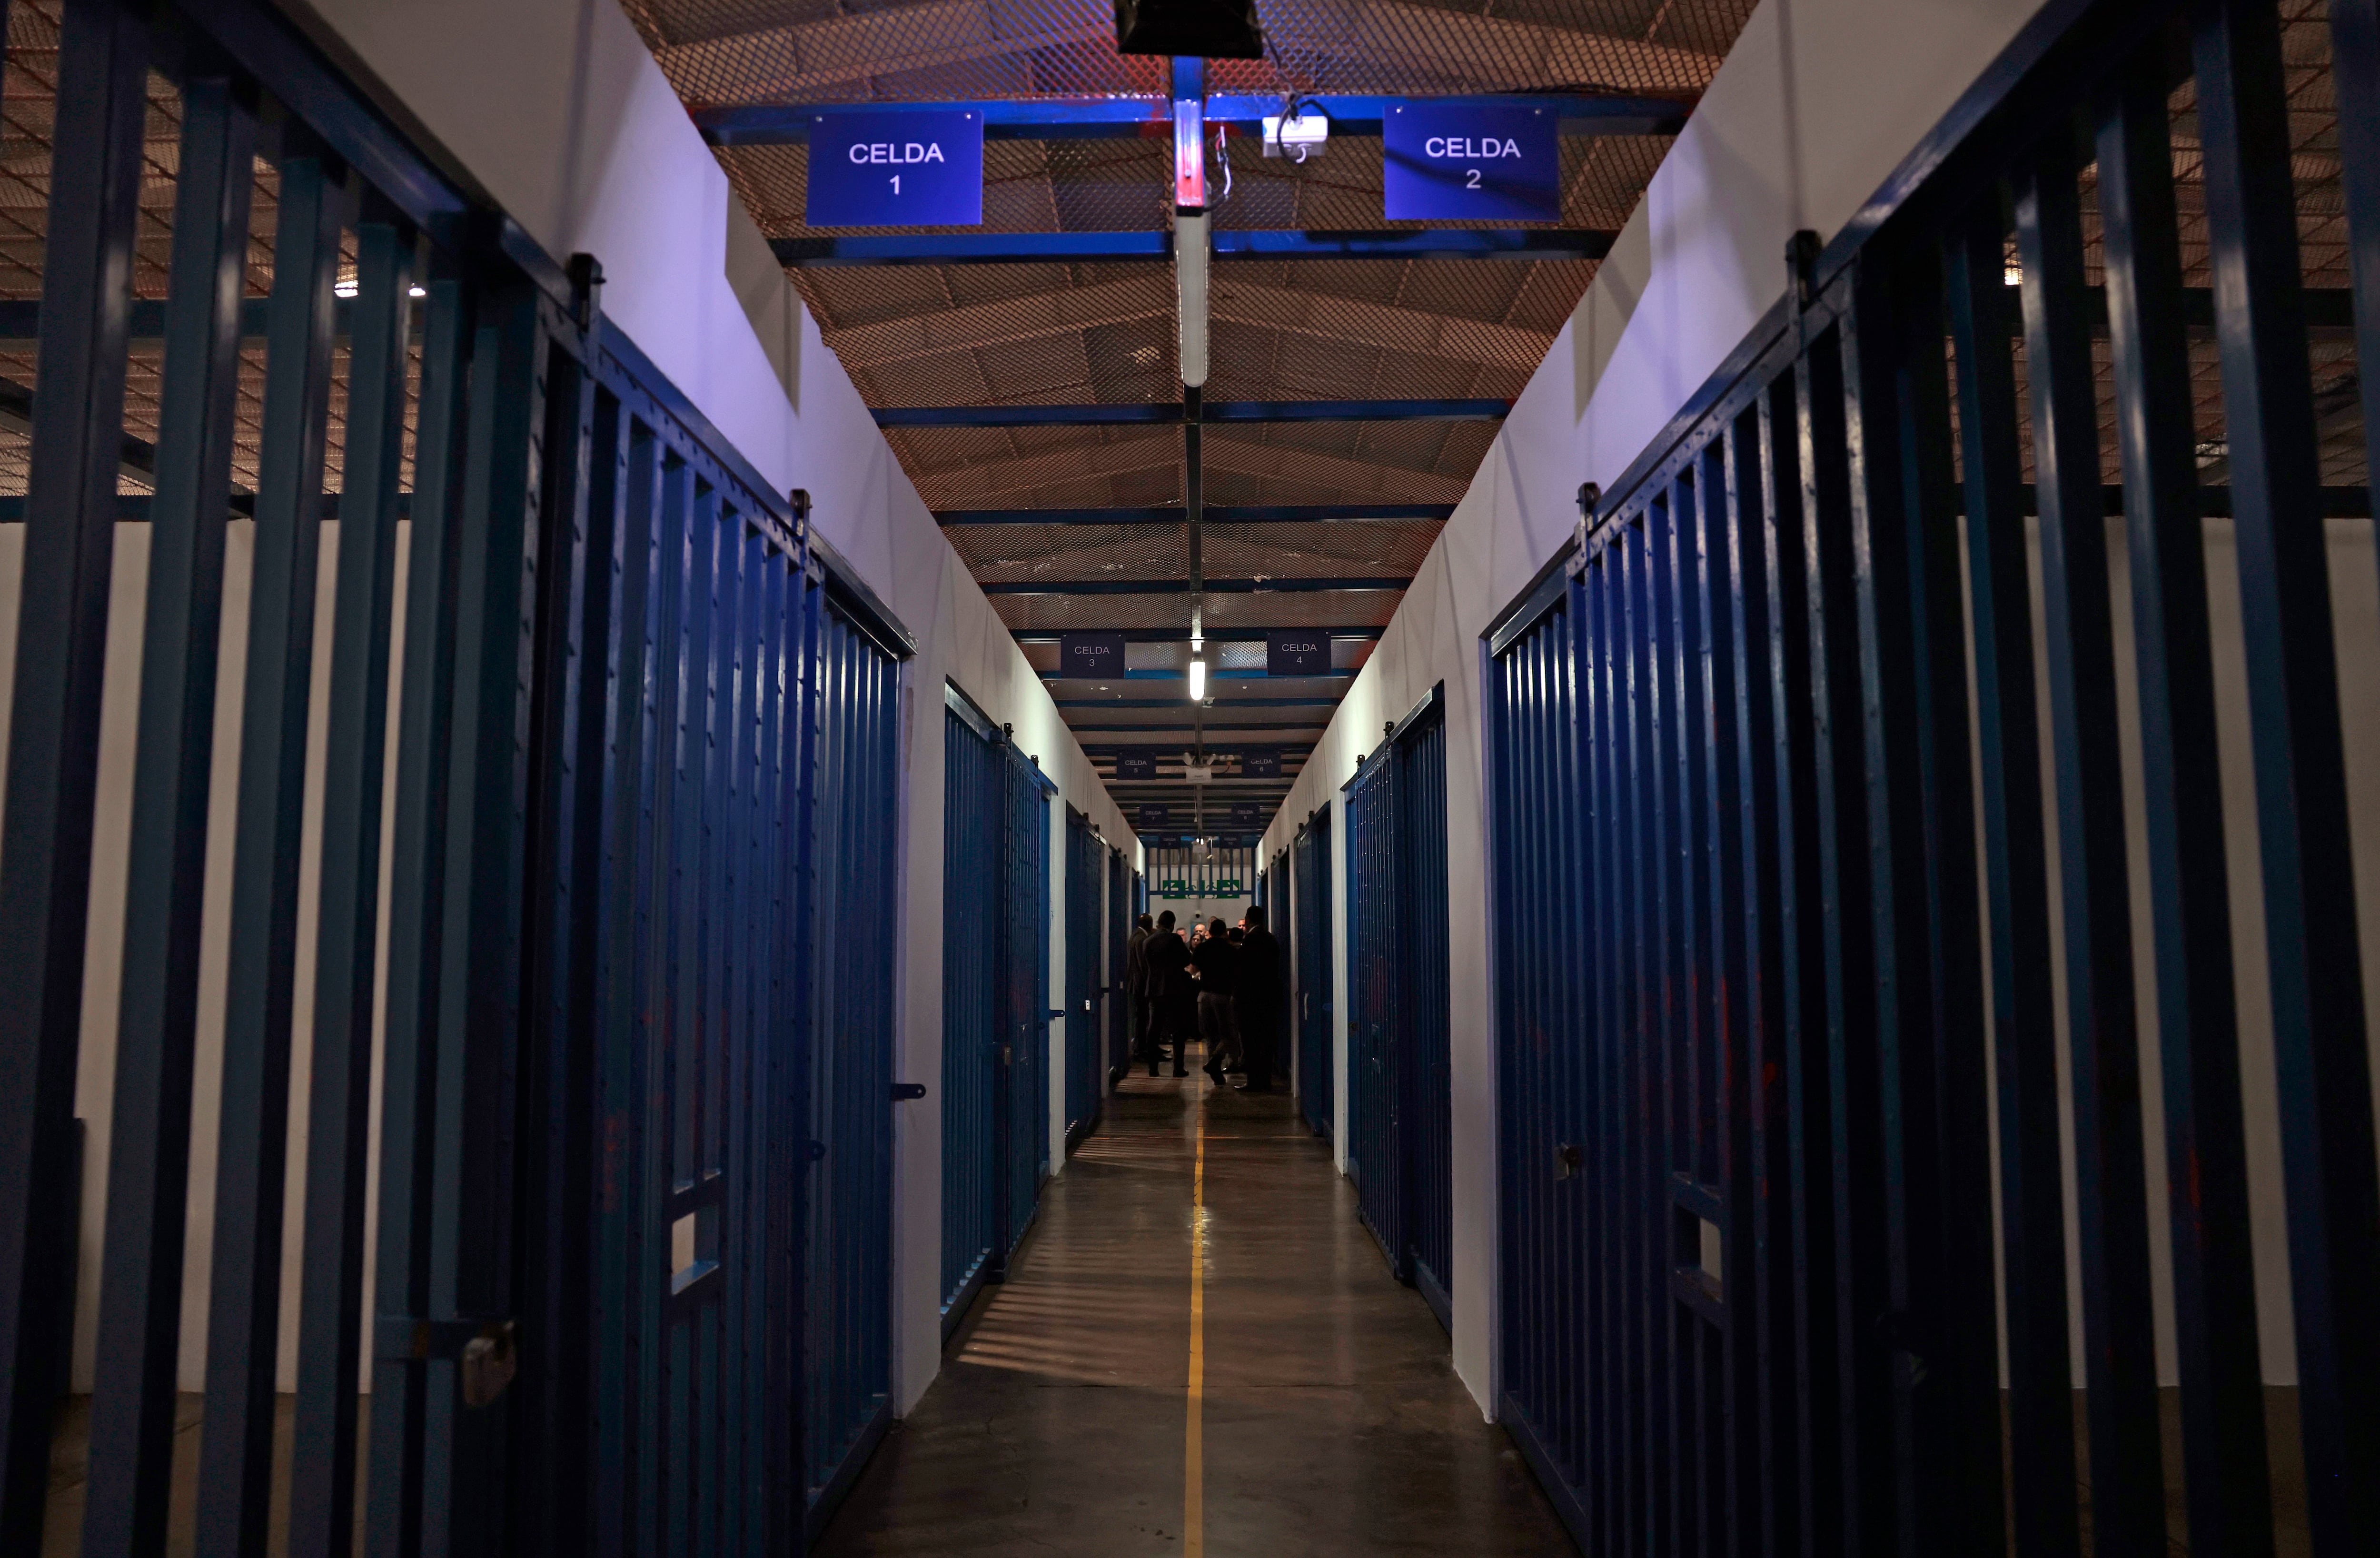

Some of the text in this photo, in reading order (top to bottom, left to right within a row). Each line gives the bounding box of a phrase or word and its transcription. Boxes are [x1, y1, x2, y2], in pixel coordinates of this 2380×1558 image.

[849, 143, 944, 163] CELDA
[1425, 137, 1521, 158] CELDA
[890, 175, 900, 195] 1
[1466, 169, 1481, 189] 2
[1074, 646, 1110, 654] CELDA
[1282, 644, 1317, 652] CELDA
[1089, 658, 1095, 666] 3
